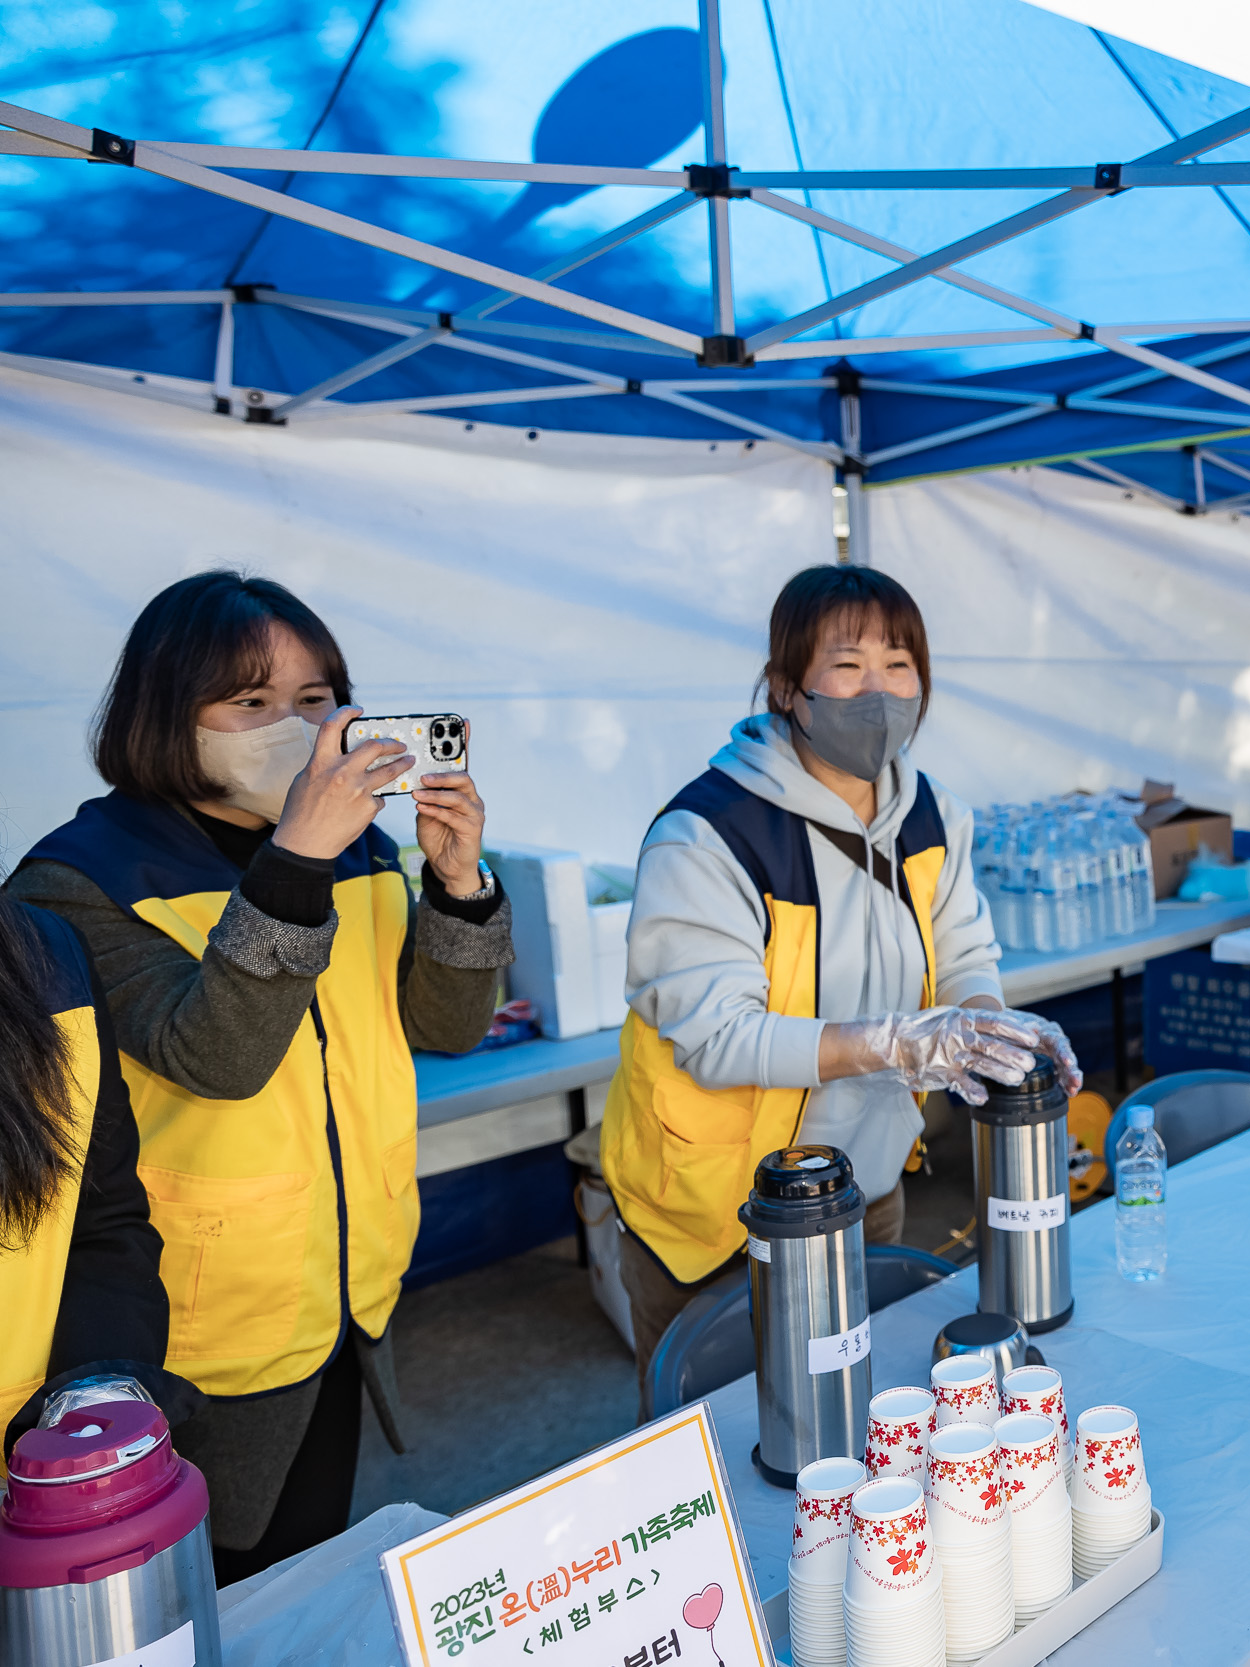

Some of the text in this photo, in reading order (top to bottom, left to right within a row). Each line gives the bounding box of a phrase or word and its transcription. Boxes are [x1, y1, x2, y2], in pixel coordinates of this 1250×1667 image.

[430, 1568, 508, 1625] 2023년
[435, 1490, 716, 1657] 광진 온(溫)누리 가족축제
